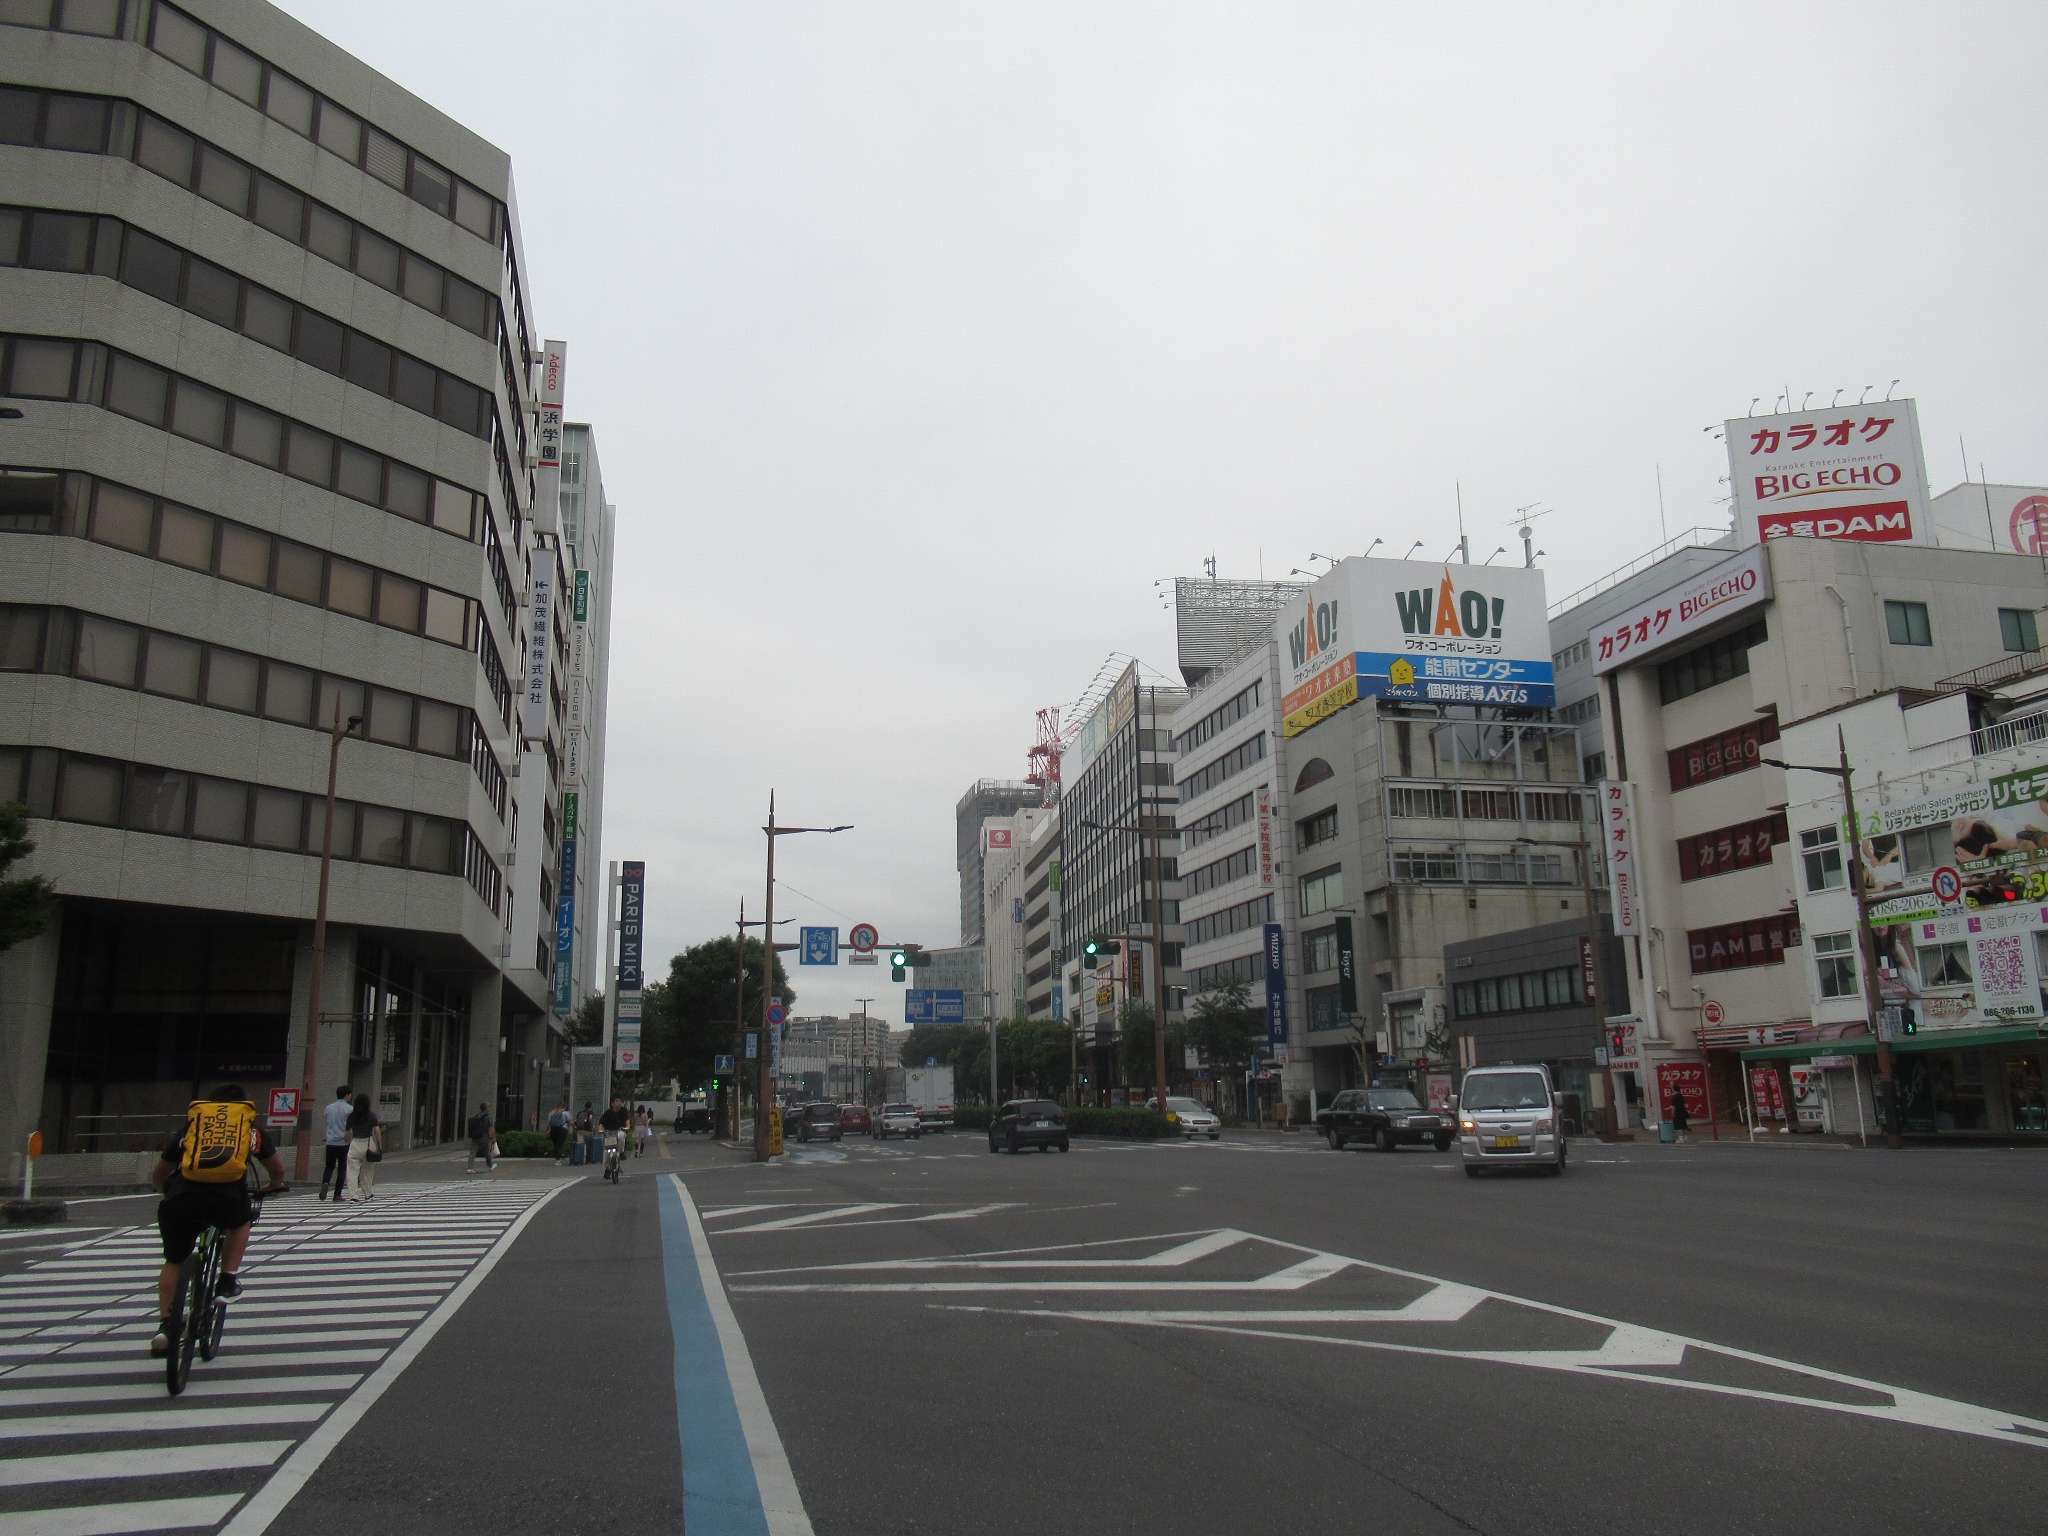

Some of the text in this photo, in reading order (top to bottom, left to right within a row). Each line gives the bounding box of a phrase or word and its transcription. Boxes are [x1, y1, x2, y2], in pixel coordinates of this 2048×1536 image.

[548, 354, 559, 390] Adecco
[1750, 417, 1894, 455] カラオケ
[1755, 463, 1901, 500] BIG ECHO
[1765, 454, 1884, 472] Karaoke Entertainment
[1395, 566, 1504, 639] WAO!
[1680, 592, 1708, 622] BIG
[1711, 569, 1756, 600] ECHO
[530, 593, 548, 704] 加茂繊維株式会社
[1289, 591, 1338, 669] WAO!
[1405, 640, 1501, 654] ワオ・コーポレーション
[1598, 608, 1672, 661] カラオケ
[1425, 658, 1525, 679] 能開センター
[1884, 788, 1988, 818] Relaxation Salon Rithera
[1886, 798, 1990, 830] リラクゼーションサロン
[1609, 786, 1628, 862] カラオケ
[560, 901, 570, 950] イーオン
[624, 884, 639, 982] PARIS MIKI
[1272, 932, 1280, 969] MIZUHO
[1272, 992, 1282, 1034] みずほ銀行
[1984, 1005, 2035, 1017] 086-206-1130
[202, 1116, 215, 1146] FACE
[214, 1105, 228, 1145] NORTH
[225, 1122, 238, 1146] THE
